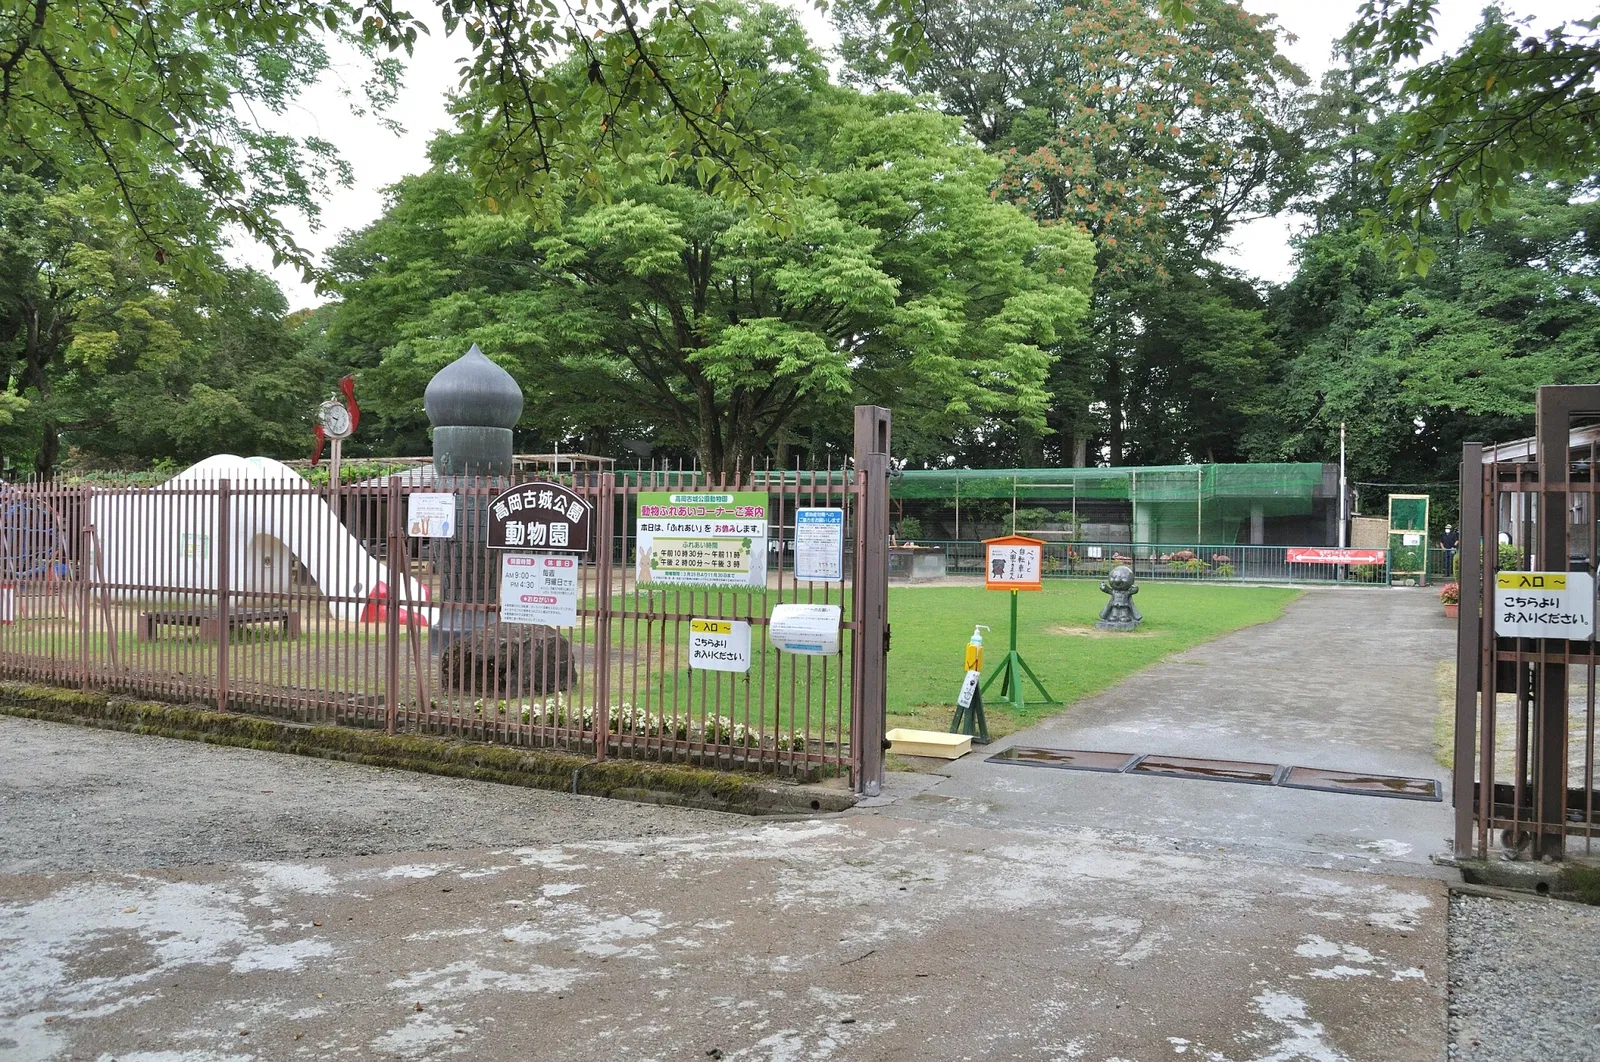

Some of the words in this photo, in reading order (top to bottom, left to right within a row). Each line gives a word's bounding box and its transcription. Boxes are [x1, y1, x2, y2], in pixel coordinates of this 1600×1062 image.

[493, 490, 585, 524] 高岡古城公園
[641, 505, 764, 518] 動物ふれあいコーナーご案内
[505, 521, 569, 546] 動物園
[641, 523, 711, 533] 本日は、「ふれあい」を
[715, 524, 760, 533] お休みします。
[682, 541, 718, 549] ふれあい時間
[1017, 548, 1025, 578] 自転車は
[1026, 550, 1034, 572] ペットと
[542, 569, 555, 577] 毎週
[1519, 576, 1544, 587] 入口
[1504, 597, 1560, 608] こちらより
[1503, 612, 1589, 626] お入りください。
[704, 623, 718, 632] 入口
[694, 638, 727, 648] こちらより
[693, 649, 745, 662] お入りください。
